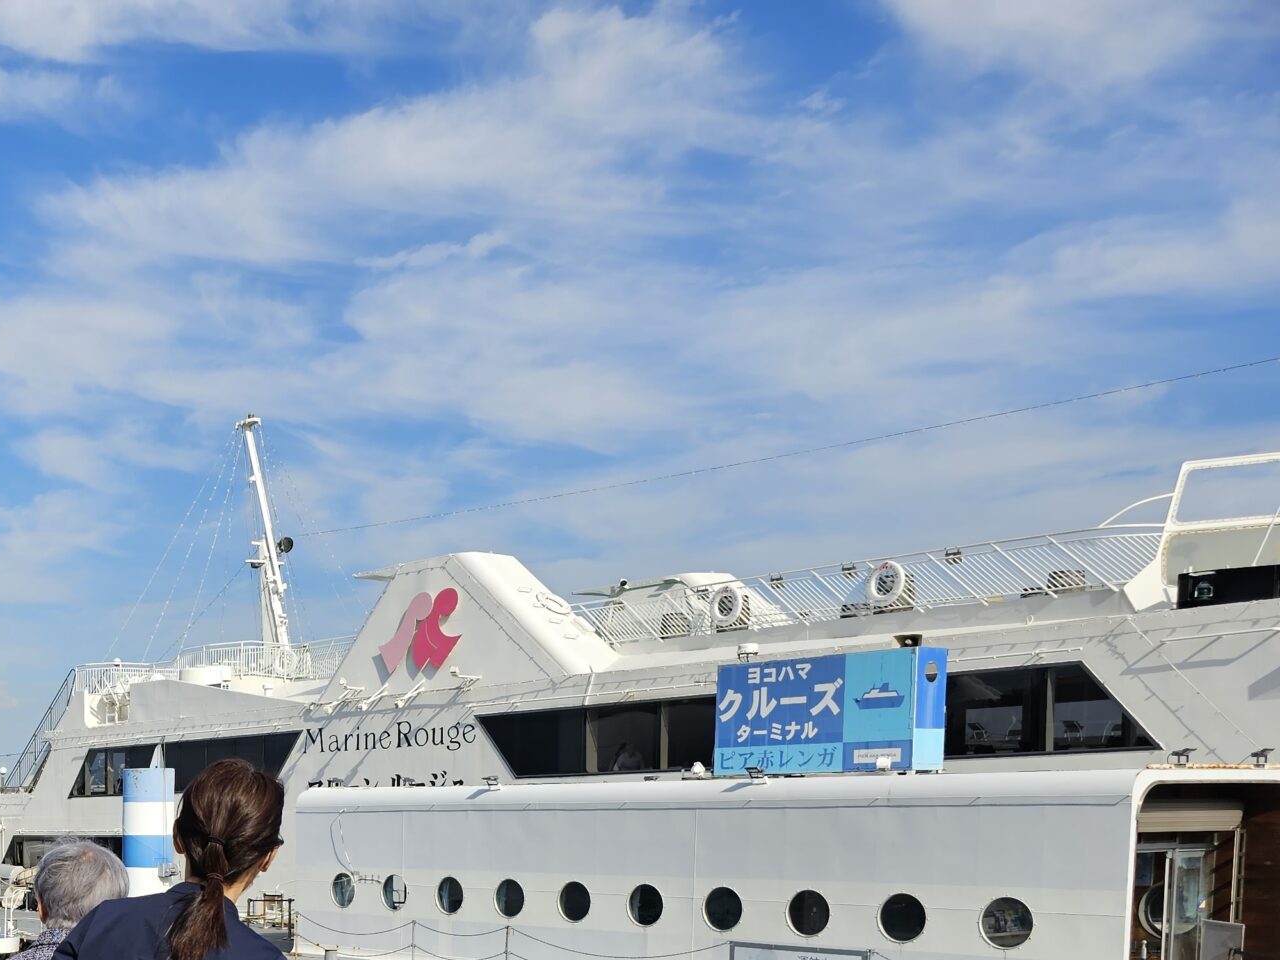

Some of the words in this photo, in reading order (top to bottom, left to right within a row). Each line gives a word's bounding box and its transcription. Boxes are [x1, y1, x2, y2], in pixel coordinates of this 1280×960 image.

[747, 663, 812, 684] ヨコハマ
[718, 677, 844, 722] クルーズ
[736, 721, 818, 743] ターミナル
[720, 746, 838, 770] ピア赤レンガ
